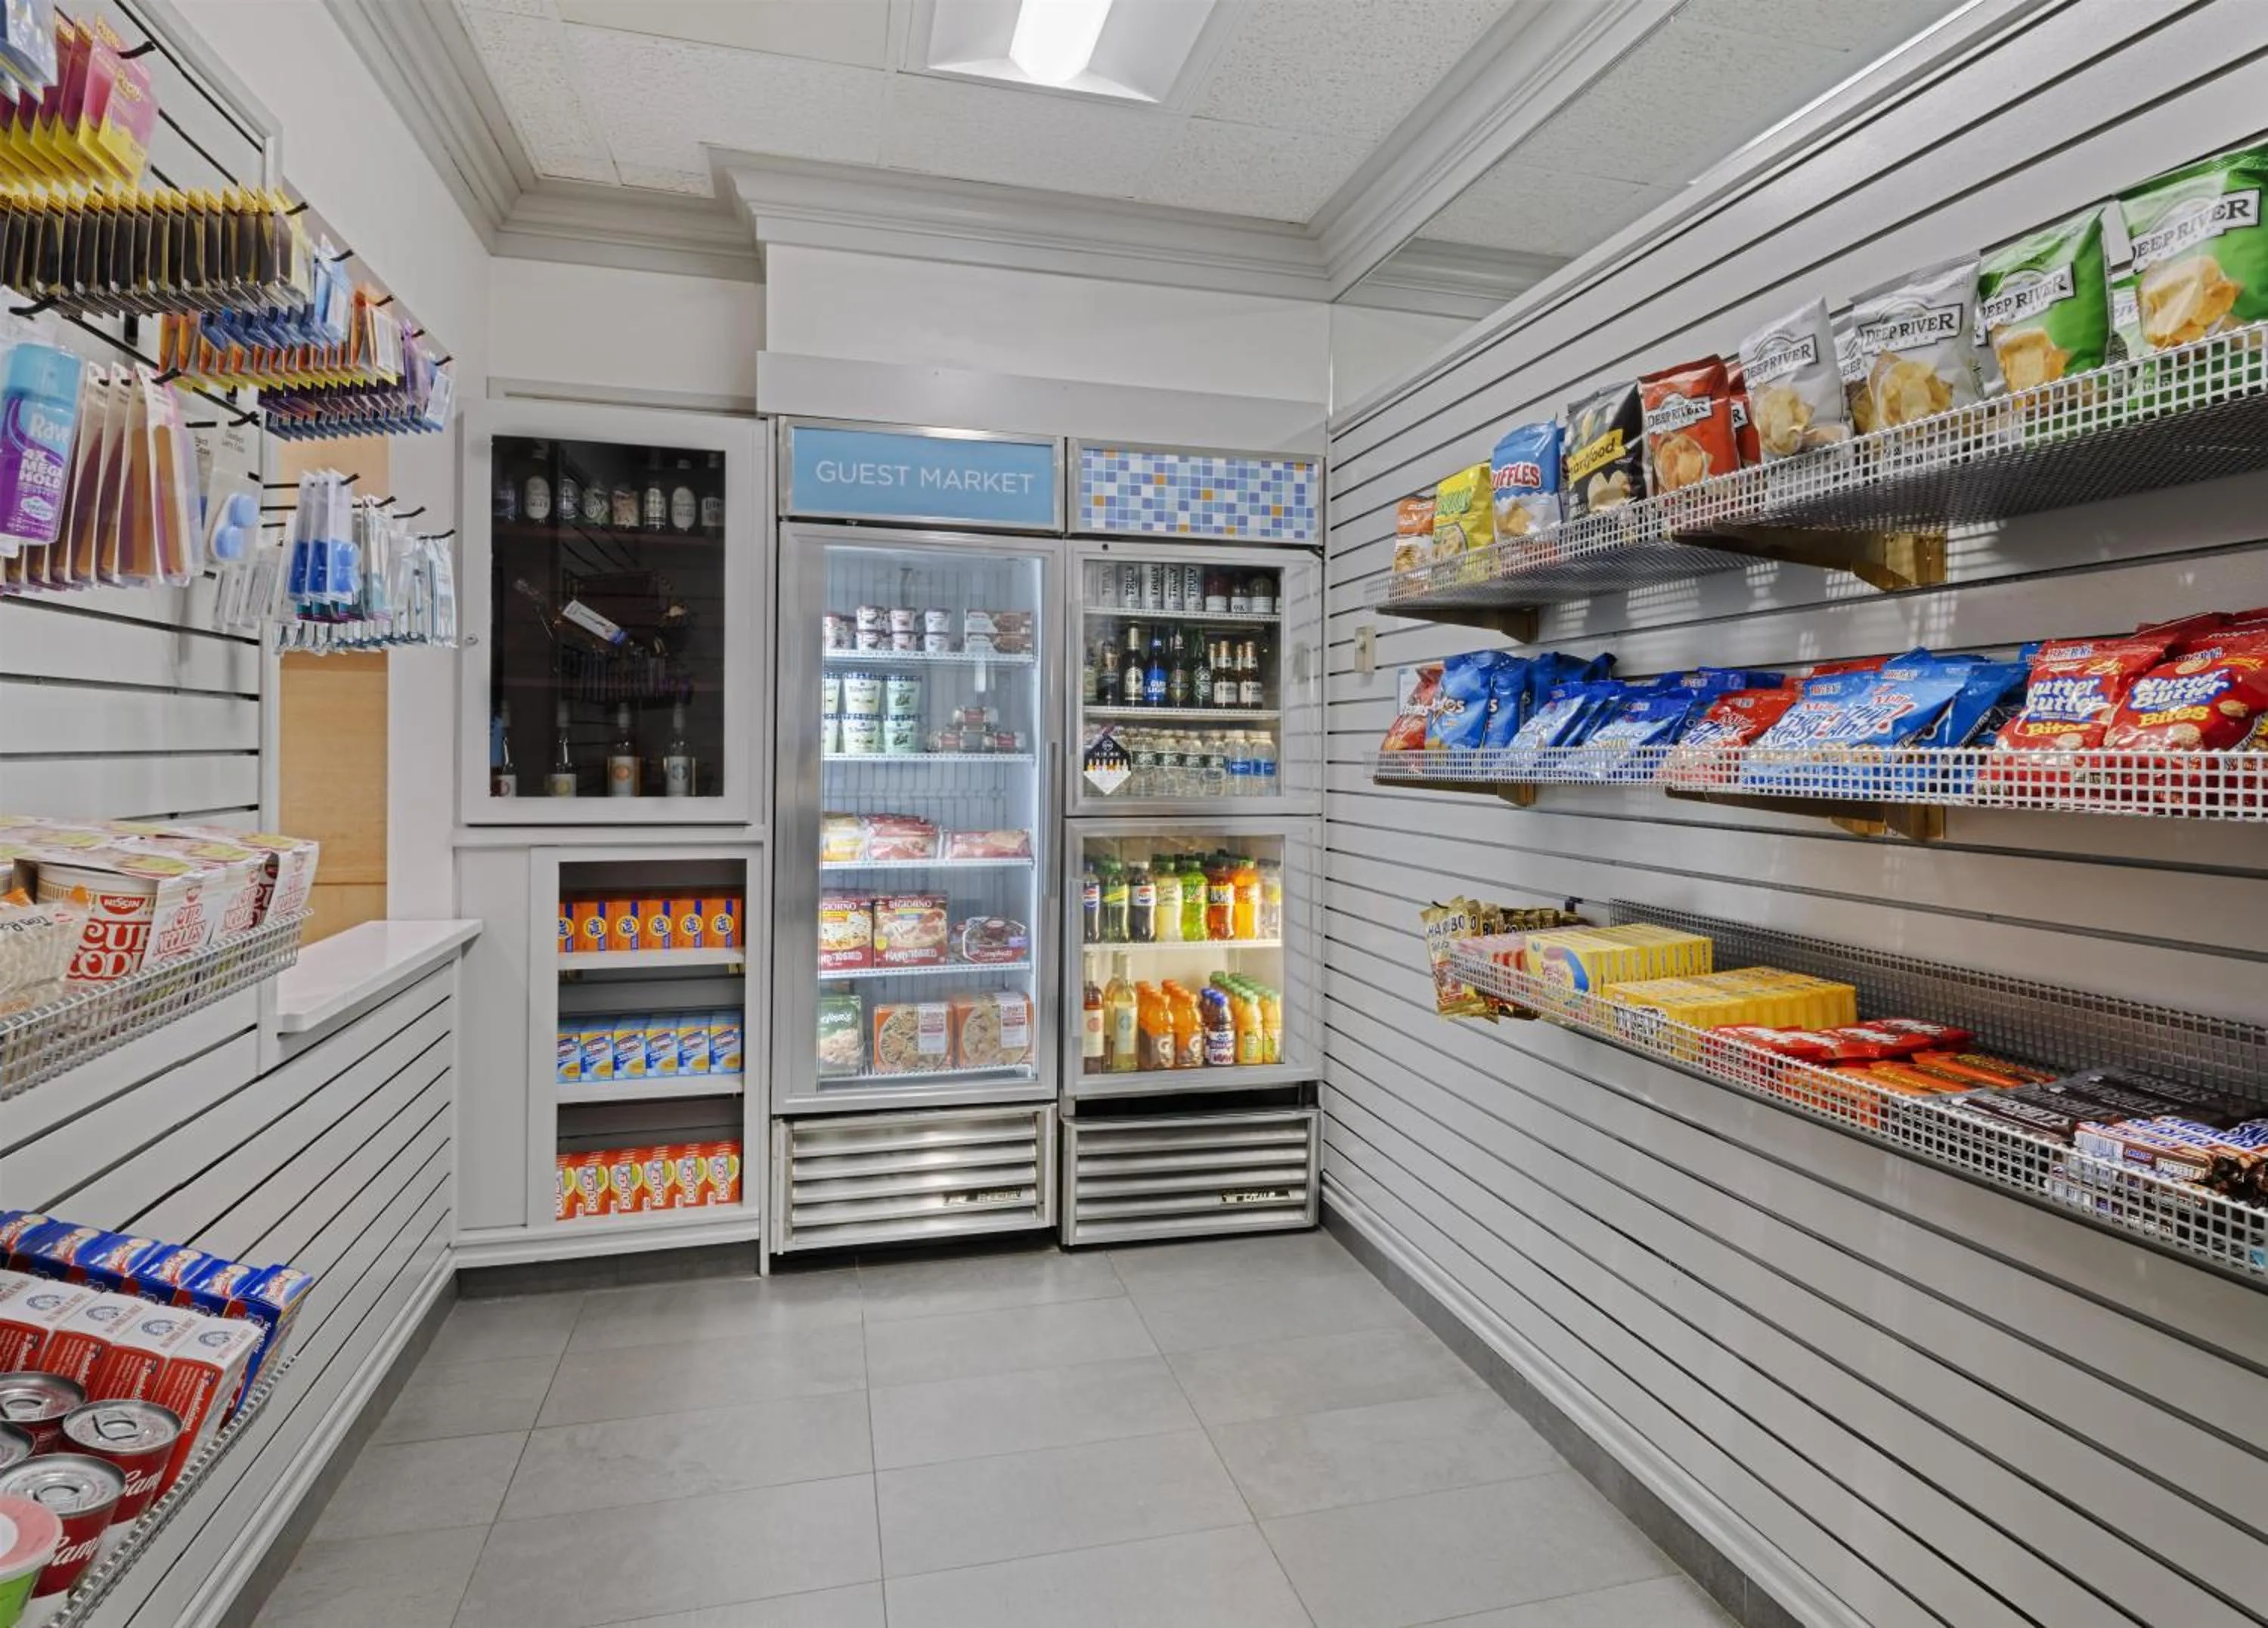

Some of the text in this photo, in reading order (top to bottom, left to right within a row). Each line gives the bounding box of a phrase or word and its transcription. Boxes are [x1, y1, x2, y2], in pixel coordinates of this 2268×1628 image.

[2177, 198, 2251, 241] RIVER
[1899, 312, 1955, 337] RIVER
[1770, 343, 1812, 367] RIVER
[815, 460, 1035, 495] GUEST MARKET
[1491, 463, 1540, 490] UFFLES
[1186, 567, 1198, 599] TRULY
[2138, 706, 2210, 727] Bites
[104, 896, 141, 909] NISSIN
